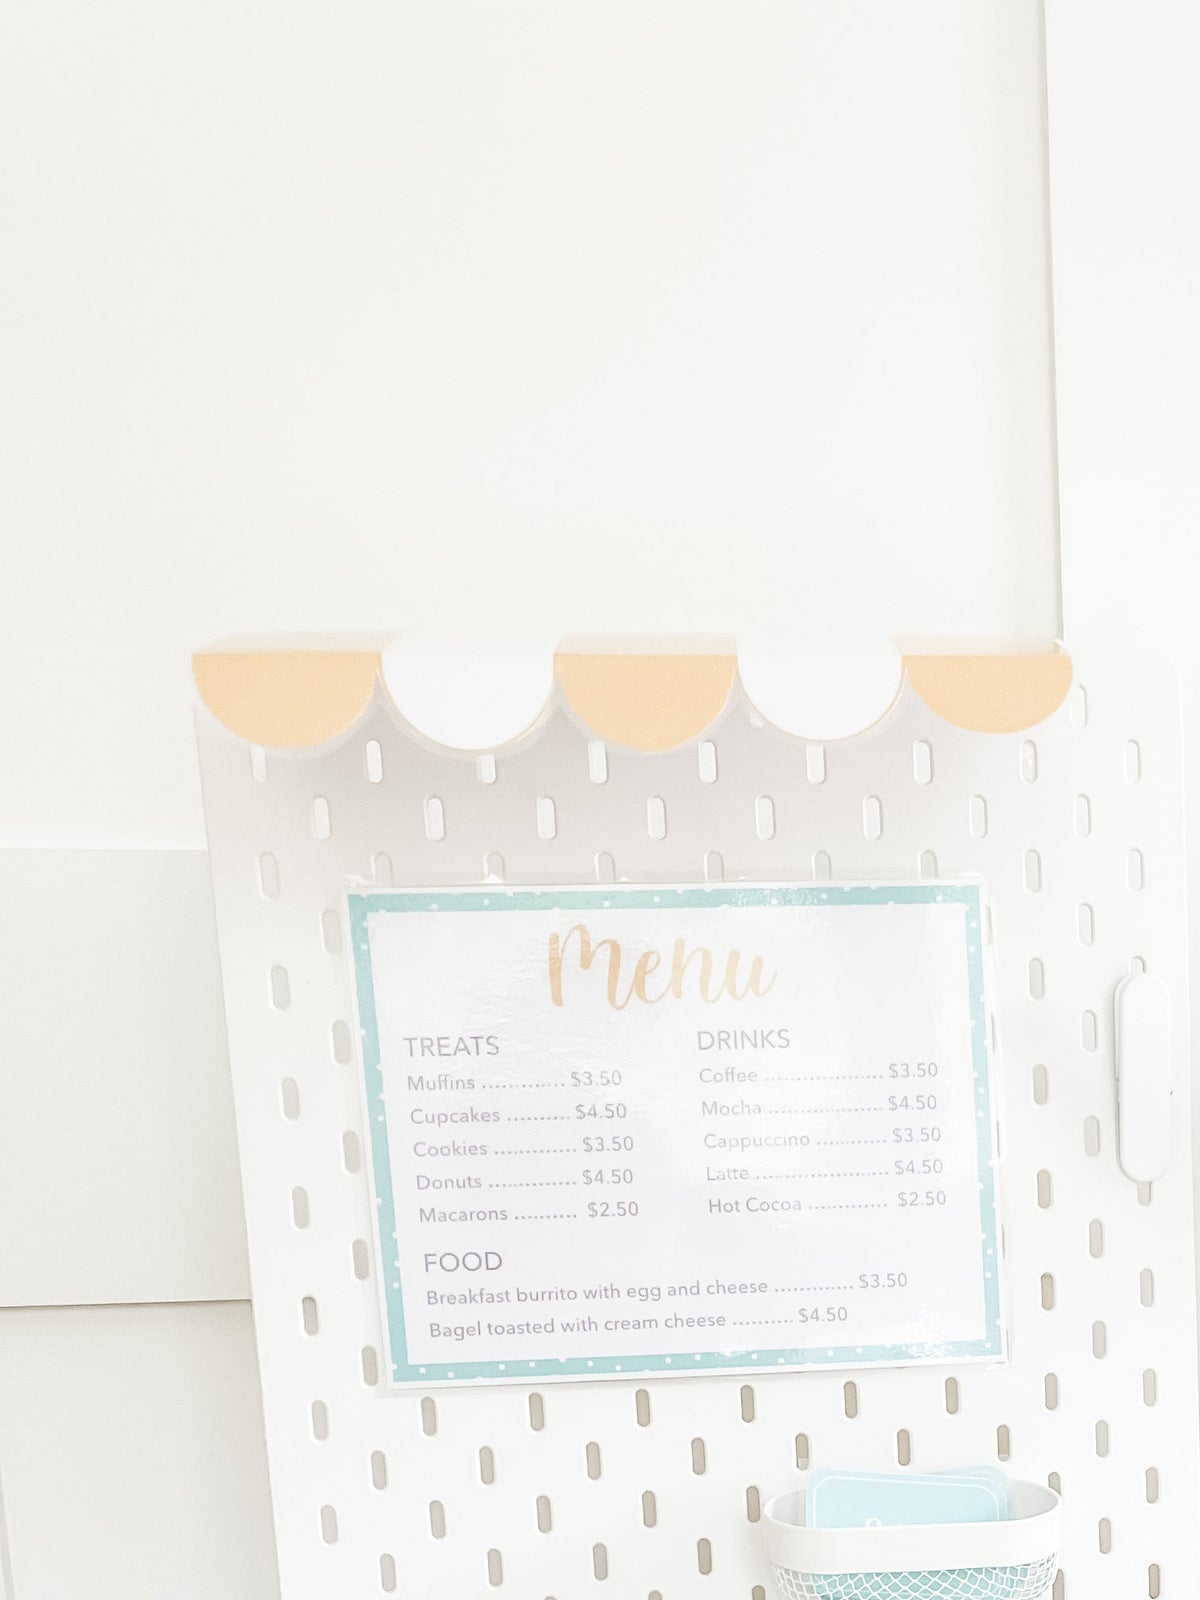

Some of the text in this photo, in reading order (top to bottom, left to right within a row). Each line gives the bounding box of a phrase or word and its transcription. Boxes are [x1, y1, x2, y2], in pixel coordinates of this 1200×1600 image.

[548, 924, 777, 1009] Menu
[404, 1036, 499, 1057] TREATS
[697, 1029, 790, 1049] DRINKS
[407, 1069, 622, 1092] Muffins $3.50
[699, 1062, 938, 1084] Coffee $3.50
[410, 1102, 627, 1126] Cupcakes $4.50
[702, 1094, 937, 1116] Mocha $4.50
[414, 1135, 634, 1157] Cookies $3.50
[704, 1126, 941, 1151] Cappuccino $3.50
[416, 1168, 633, 1190] Donuts $4.50
[707, 1158, 943, 1181] Latte $4.50
[420, 1200, 639, 1223] Macarons $2.50
[708, 1190, 947, 1214] Hot Cocoa $2.50
[424, 1251, 503, 1272] FOOD
[427, 1271, 908, 1306] Breakfast burrito with egg and cheese $3.50
[430, 1306, 848, 1341] Bagel toasted with cream cheese $4.50
